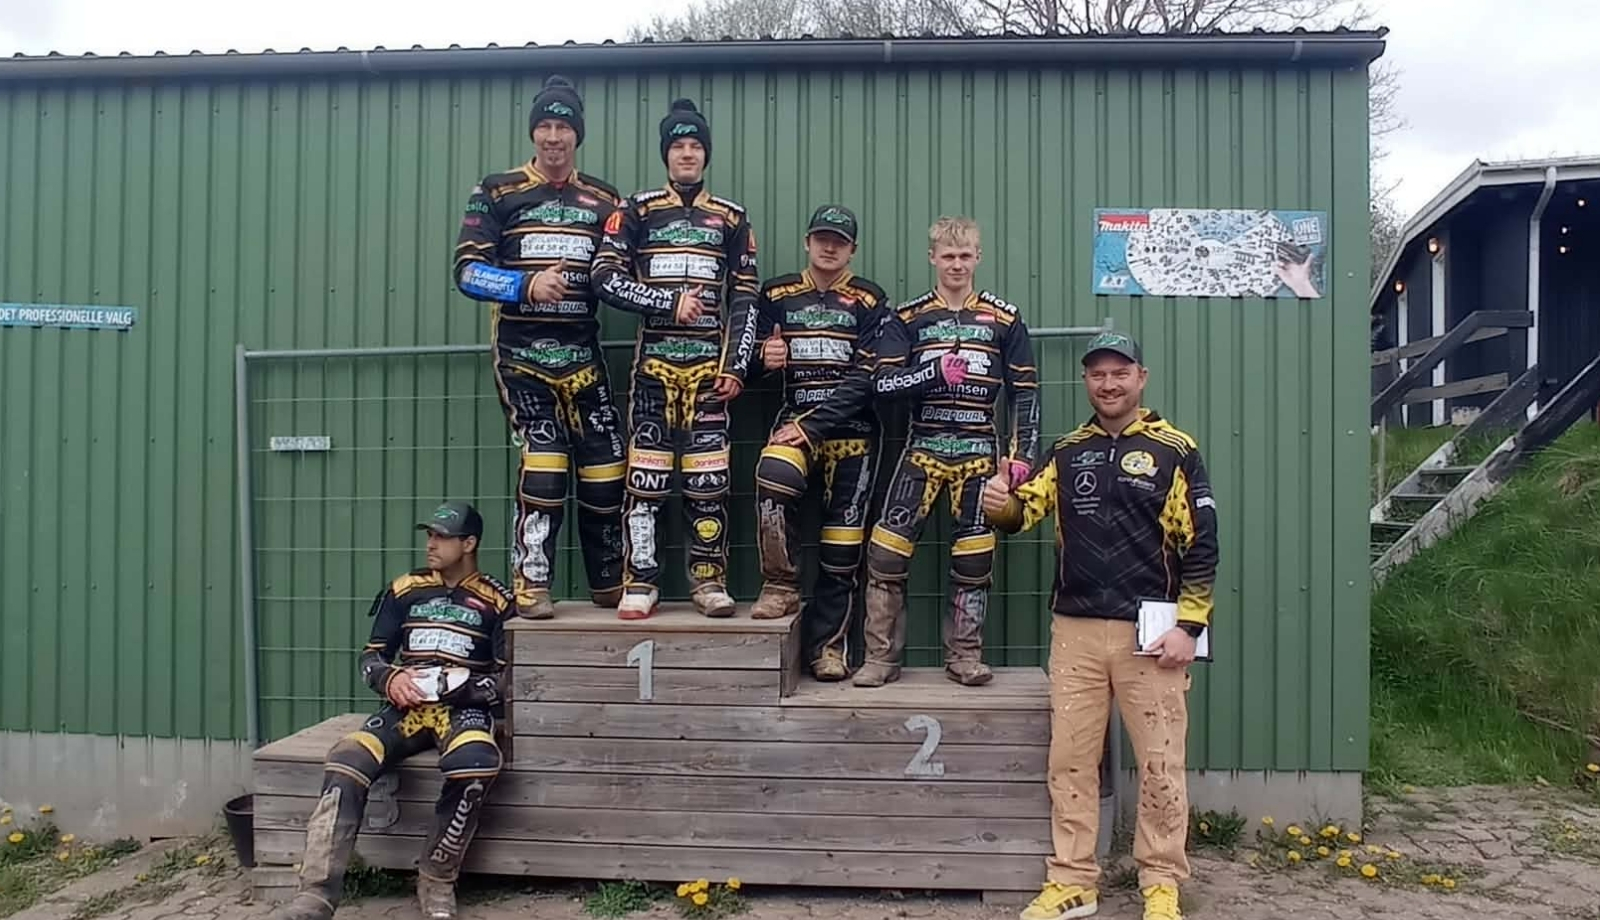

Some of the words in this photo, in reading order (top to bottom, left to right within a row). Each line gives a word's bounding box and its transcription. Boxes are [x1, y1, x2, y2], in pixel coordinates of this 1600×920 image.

[1098, 219, 1150, 232] makita
[980, 291, 1018, 315] MOR
[0, 308, 16, 321] DET
[19, 309, 104, 323] PROFESSIONELLE
[105, 311, 132, 325] VALG
[631, 471, 669, 488] QNT
[627, 640, 654, 700] 1
[904, 714, 945, 777] 2
[430, 778, 484, 863] Camilla
